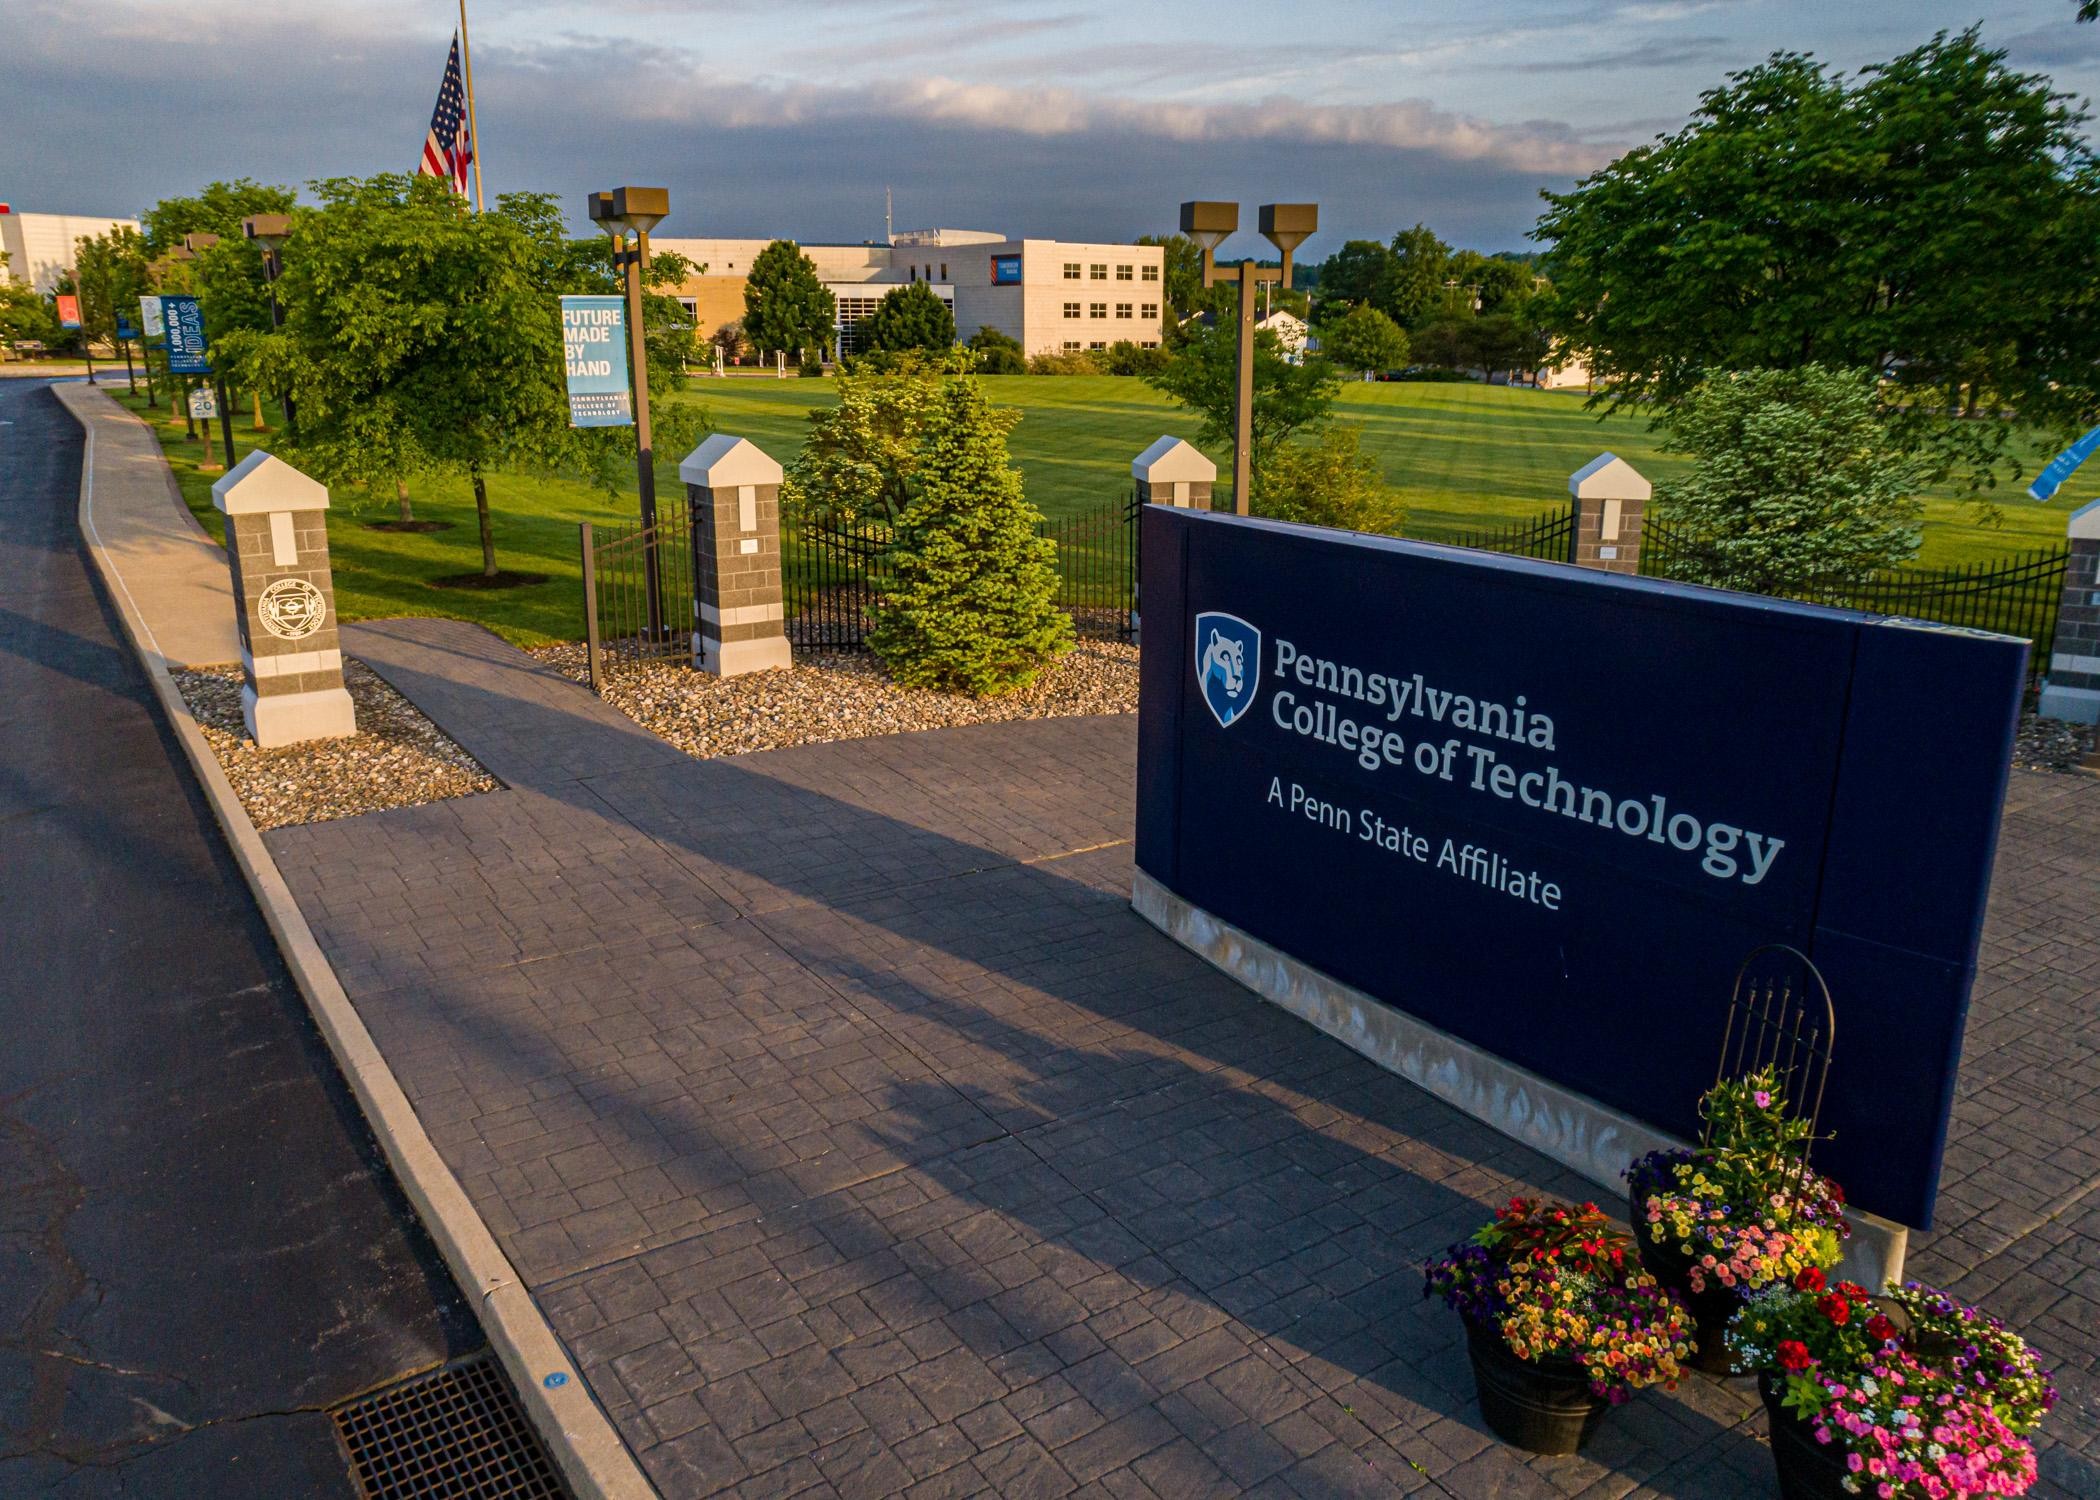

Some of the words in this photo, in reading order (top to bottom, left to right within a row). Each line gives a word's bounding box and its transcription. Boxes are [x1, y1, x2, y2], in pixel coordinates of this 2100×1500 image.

[562, 310, 621, 326] FUTURE
[179, 301, 203, 354] IDEAS
[564, 326, 610, 342] MADE
[565, 344, 584, 360] BY
[566, 360, 611, 376] HAND
[194, 401, 212, 410] 20
[1274, 638, 1557, 752] Pennsylvania
[1271, 691, 1405, 772] College
[1414, 738, 1461, 782] of
[1467, 744, 1786, 886] Technology
[1267, 776, 1285, 808] A
[1290, 782, 1351, 834] Penn
[1359, 808, 1430, 863] State
[1437, 838, 1562, 911] Affiliate
